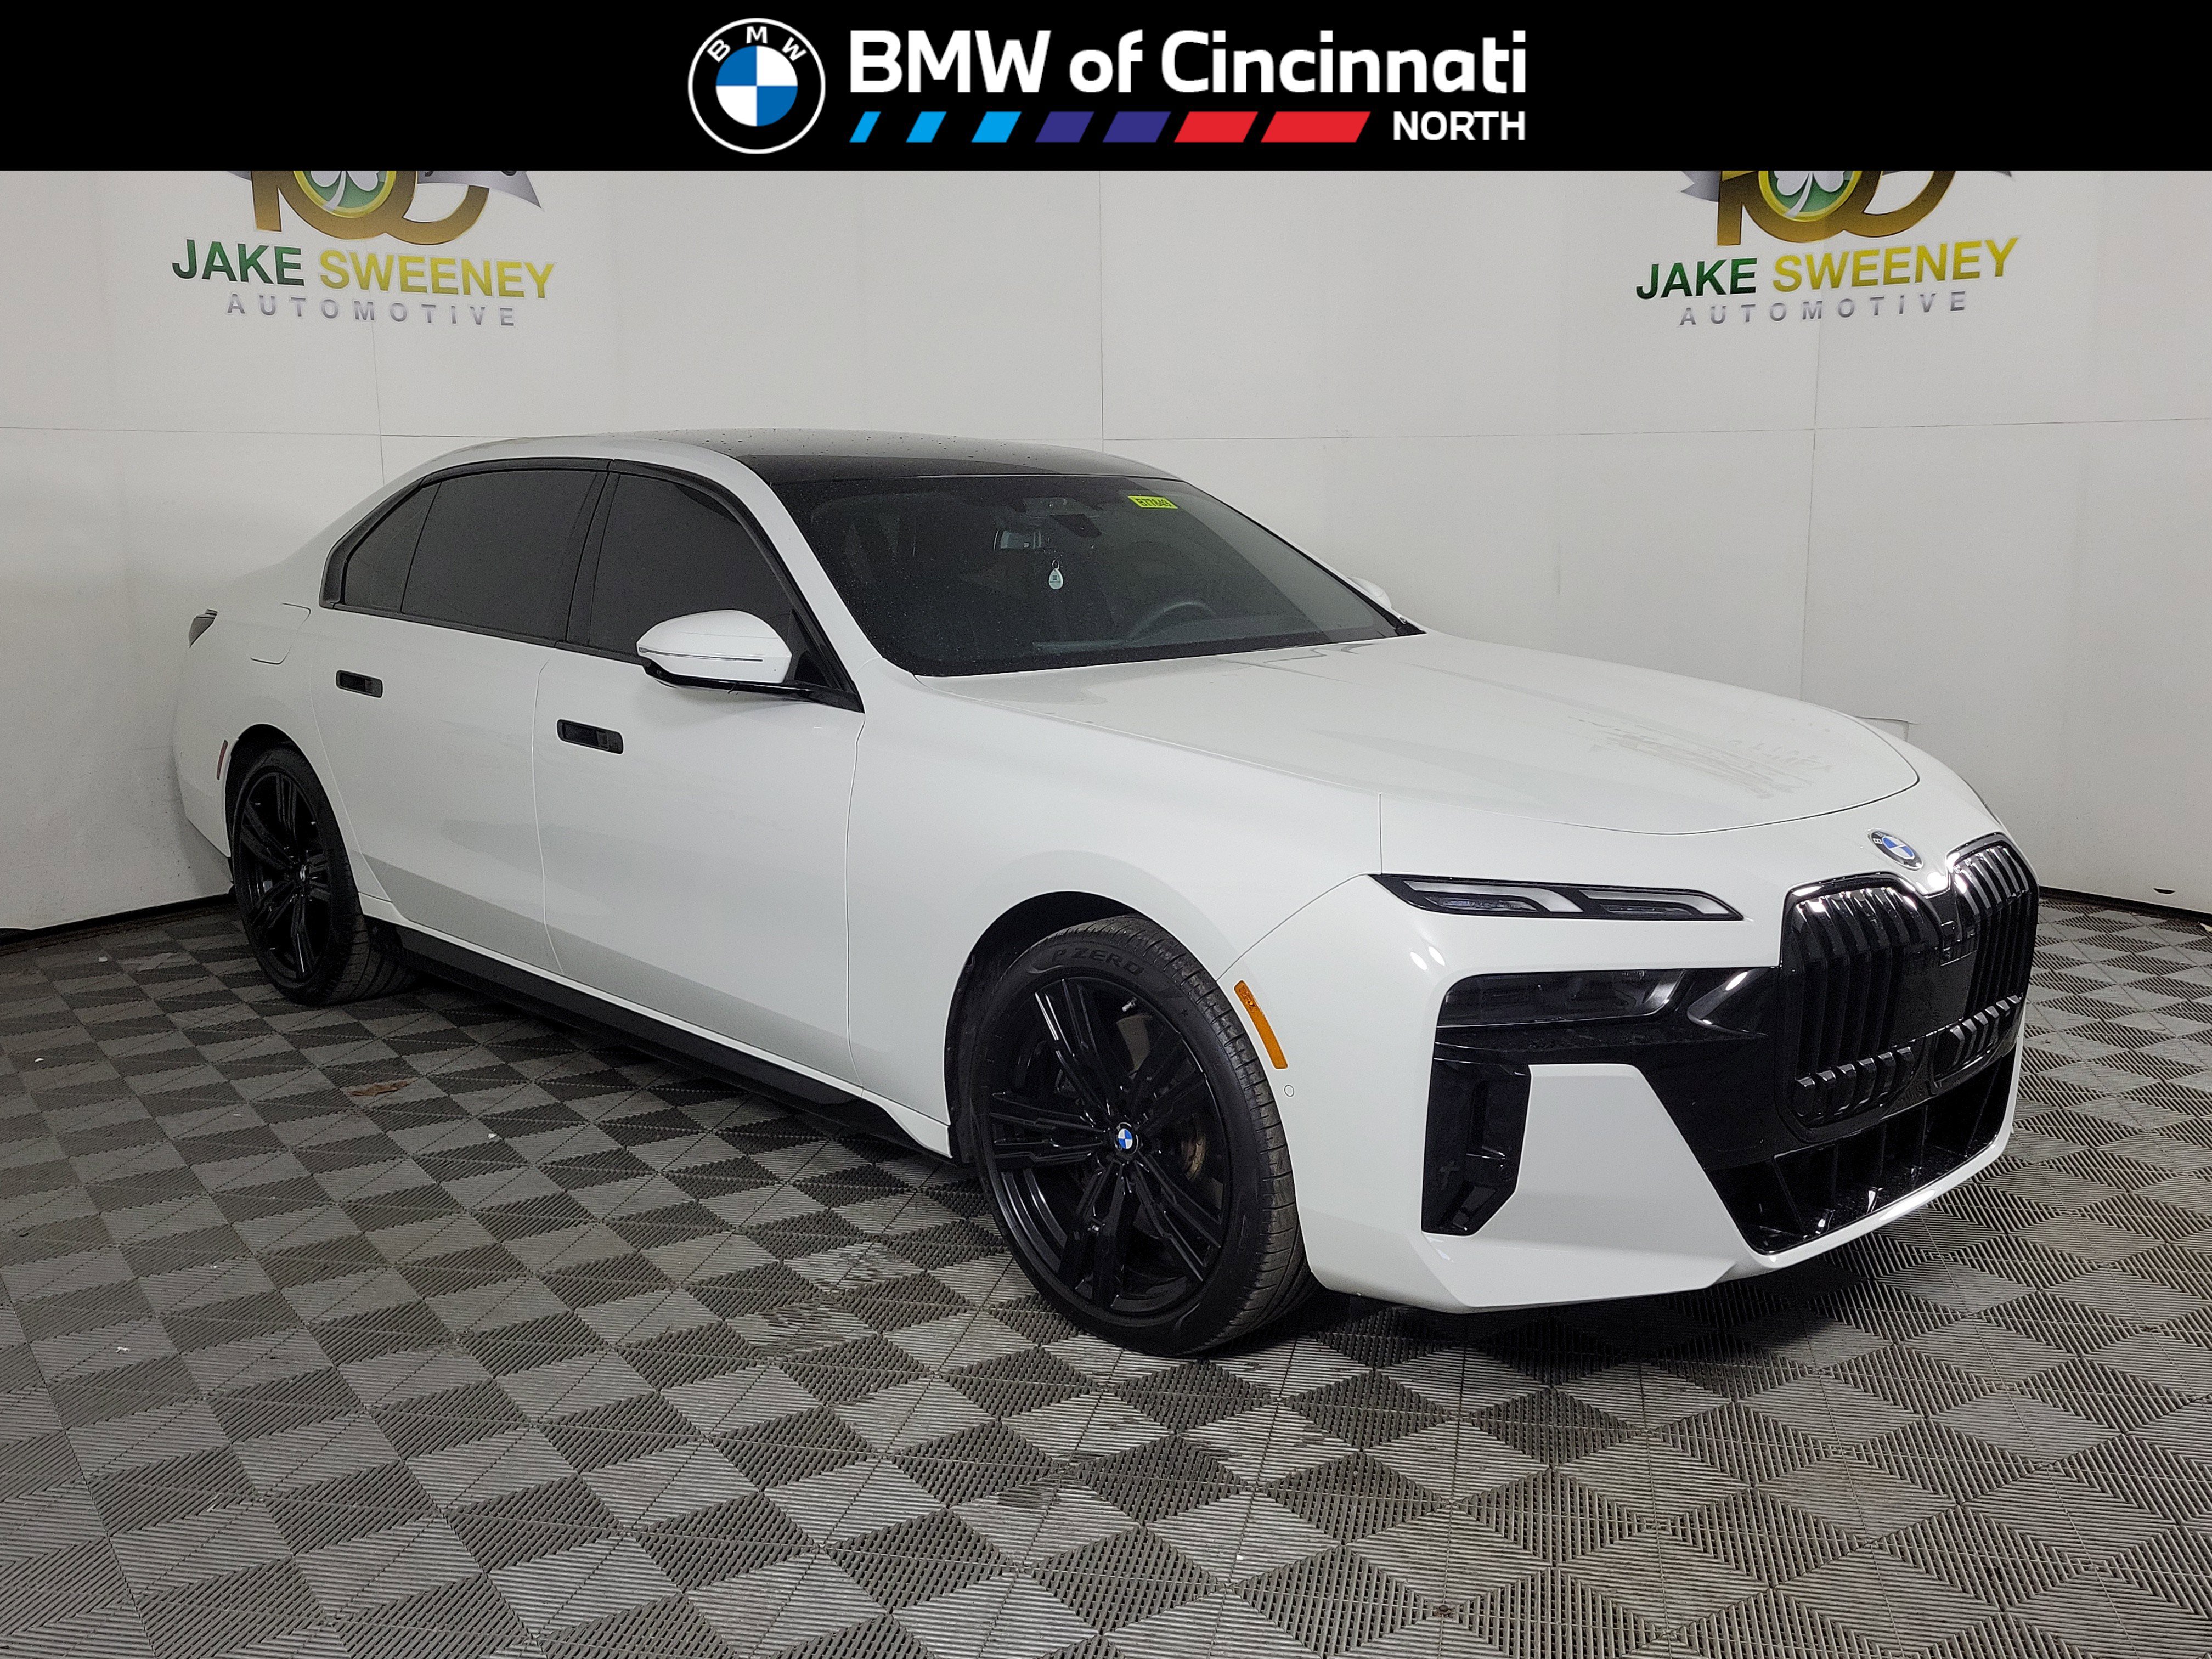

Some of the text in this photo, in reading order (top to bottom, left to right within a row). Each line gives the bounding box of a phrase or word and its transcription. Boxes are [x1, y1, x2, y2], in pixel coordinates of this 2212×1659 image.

[172, 239, 555, 298] JAKE SWEENEY
[1636, 237, 2019, 300] JAKE SWEENEY
[227, 293, 514, 326] AUTOMOTIVE
[1679, 291, 1966, 326] AUTOMOTIVE
[1052, 947, 1145, 977] P ZERO
